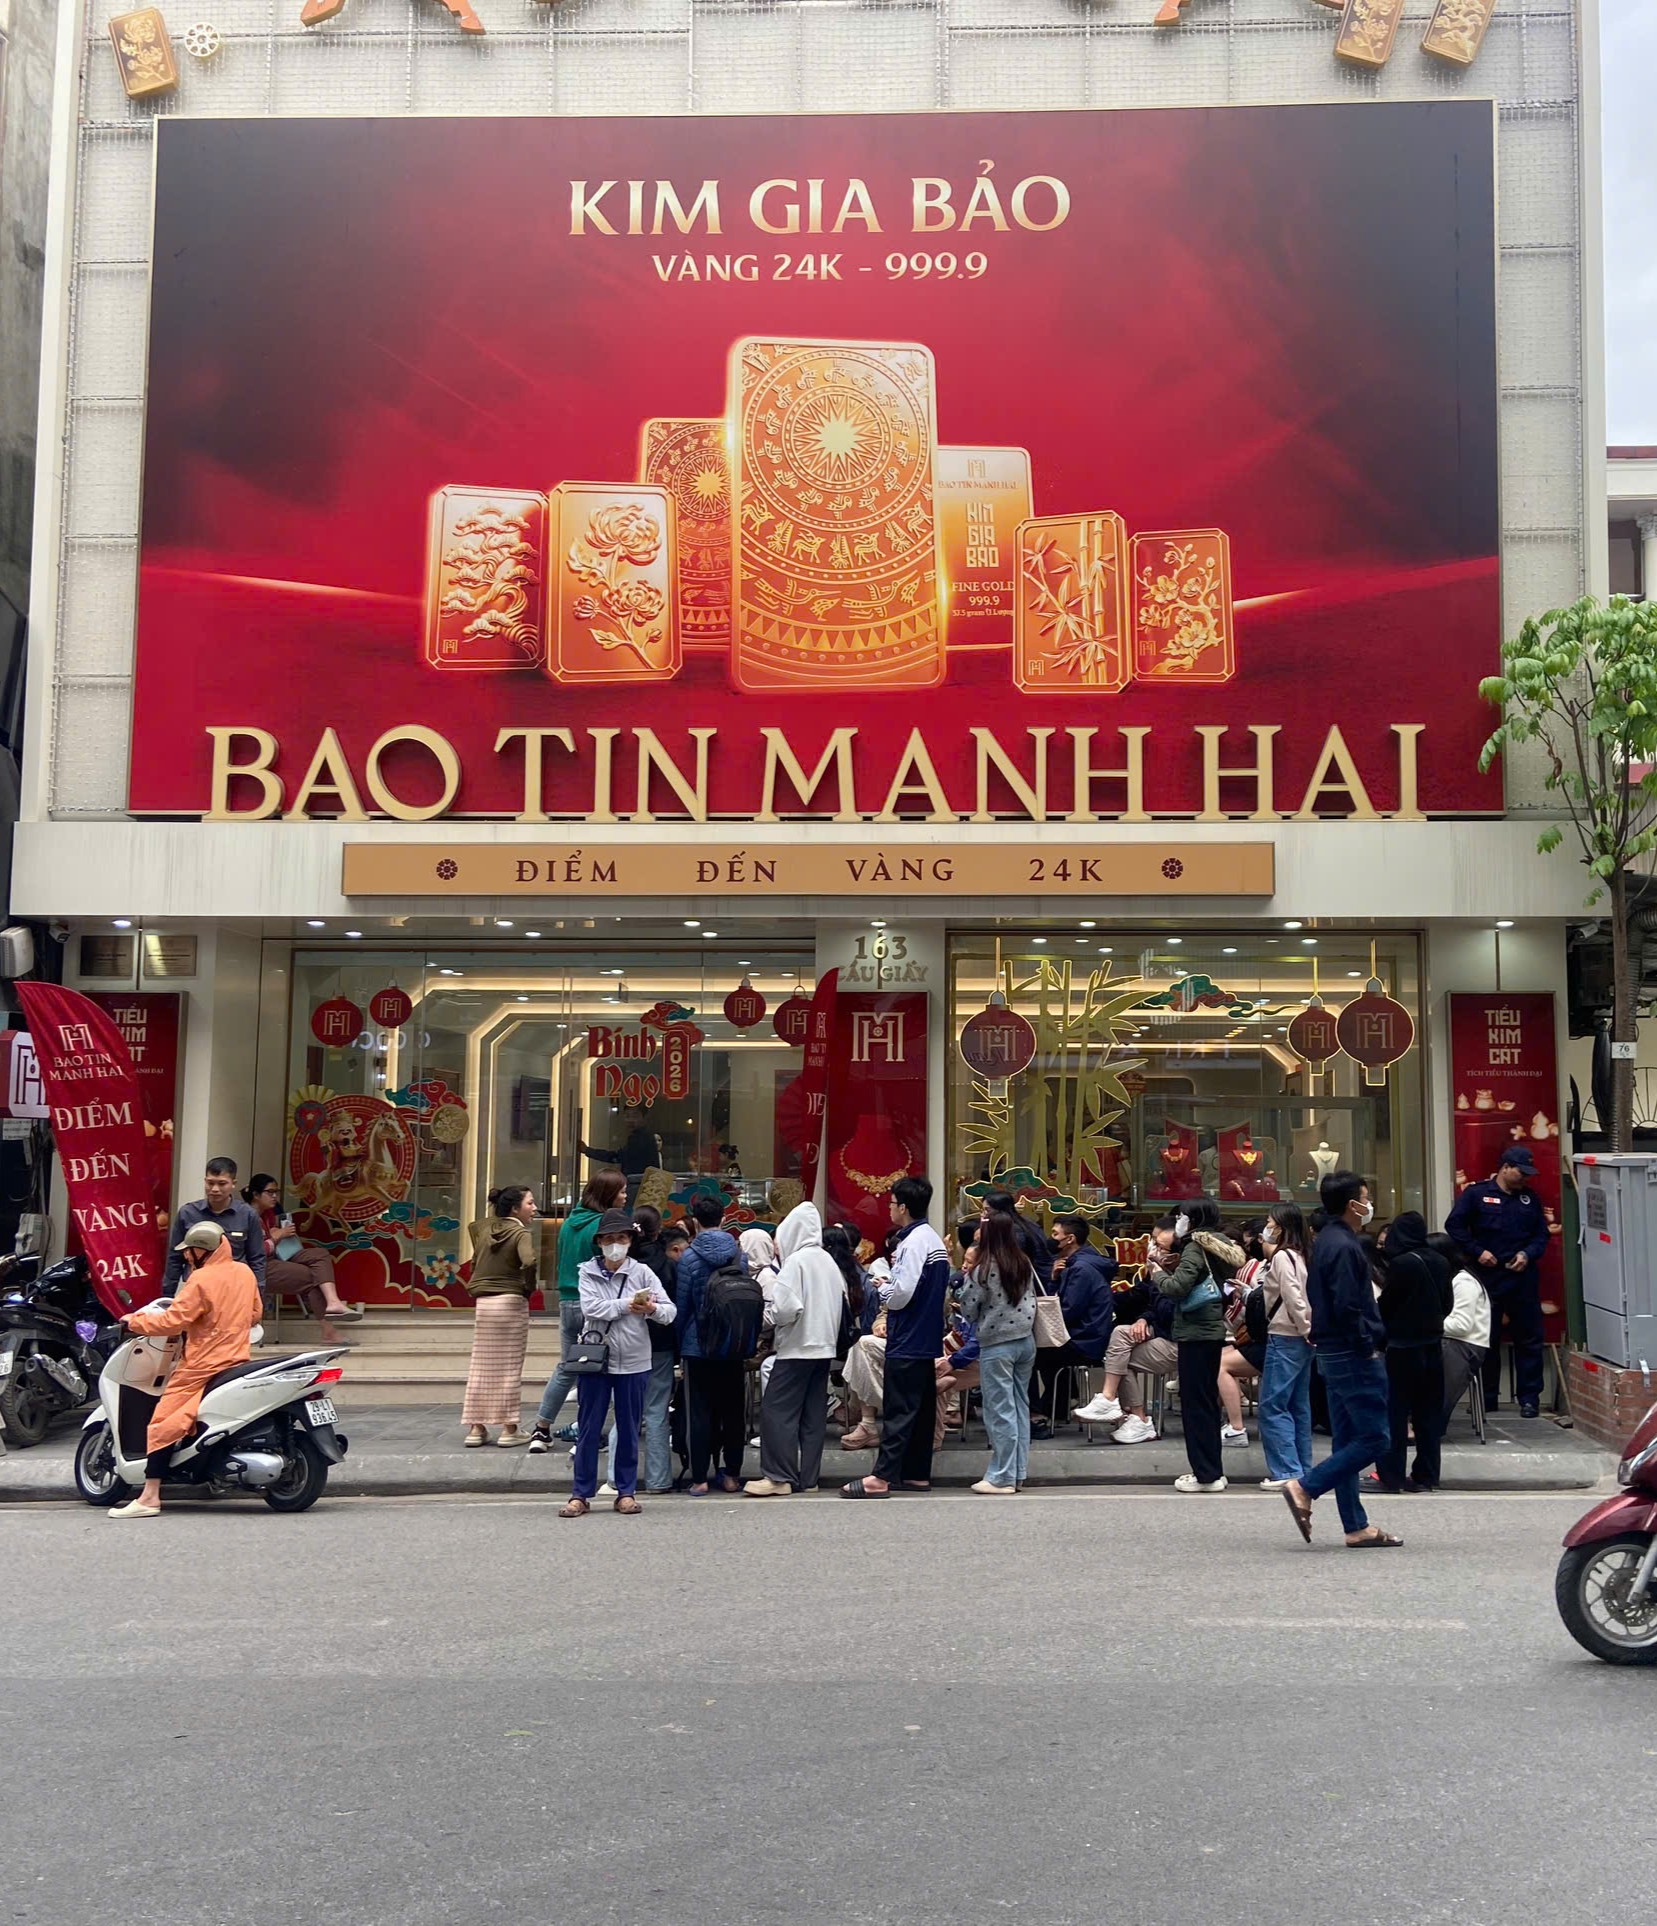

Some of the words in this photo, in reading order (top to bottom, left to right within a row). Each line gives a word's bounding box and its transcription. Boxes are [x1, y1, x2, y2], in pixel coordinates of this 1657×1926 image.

[568, 179, 724, 235] KIM
[749, 178, 885, 234] GIA
[911, 158, 1071, 232] BẢO
[651, 250, 760, 282] VÀNG
[772, 252, 843, 281] 24K
[884, 251, 989, 280] 999.9
[952, 581, 980, 592] FINE
[981, 581, 1016, 592] GOLD
[968, 594, 1001, 607] 999.9
[201, 723, 462, 821] BAO
[493, 726, 718, 822] TIN
[753, 725, 1152, 821] MANH
[1193, 723, 1428, 821] HAI
[515, 849, 619, 883] ĐIỂM
[696, 851, 778, 883] ĐẾN
[845, 852, 955, 882] VÀNG
[1028, 857, 1104, 882] 24K
[854, 935, 908, 960] 163
[1484, 1003, 1521, 1026] TIỂU
[1488, 1028, 1522, 1045] KIM
[54, 1056, 84, 1068] BAO
[85, 1053, 113, 1066] TIN
[668, 1036, 684, 1092] 2026
[1488, 1045, 1522, 1065] CÁT
[49, 1069, 94, 1081] MANH
[97, 1065, 125, 1079] HAI
[595, 1063, 661, 1109] Ngọ
[54, 1096, 134, 1132] ĐIỂM
[69, 1148, 131, 1182] ĐẾN
[73, 1201, 149, 1233] VÀNG
[96, 1253, 149, 1282] 24K
